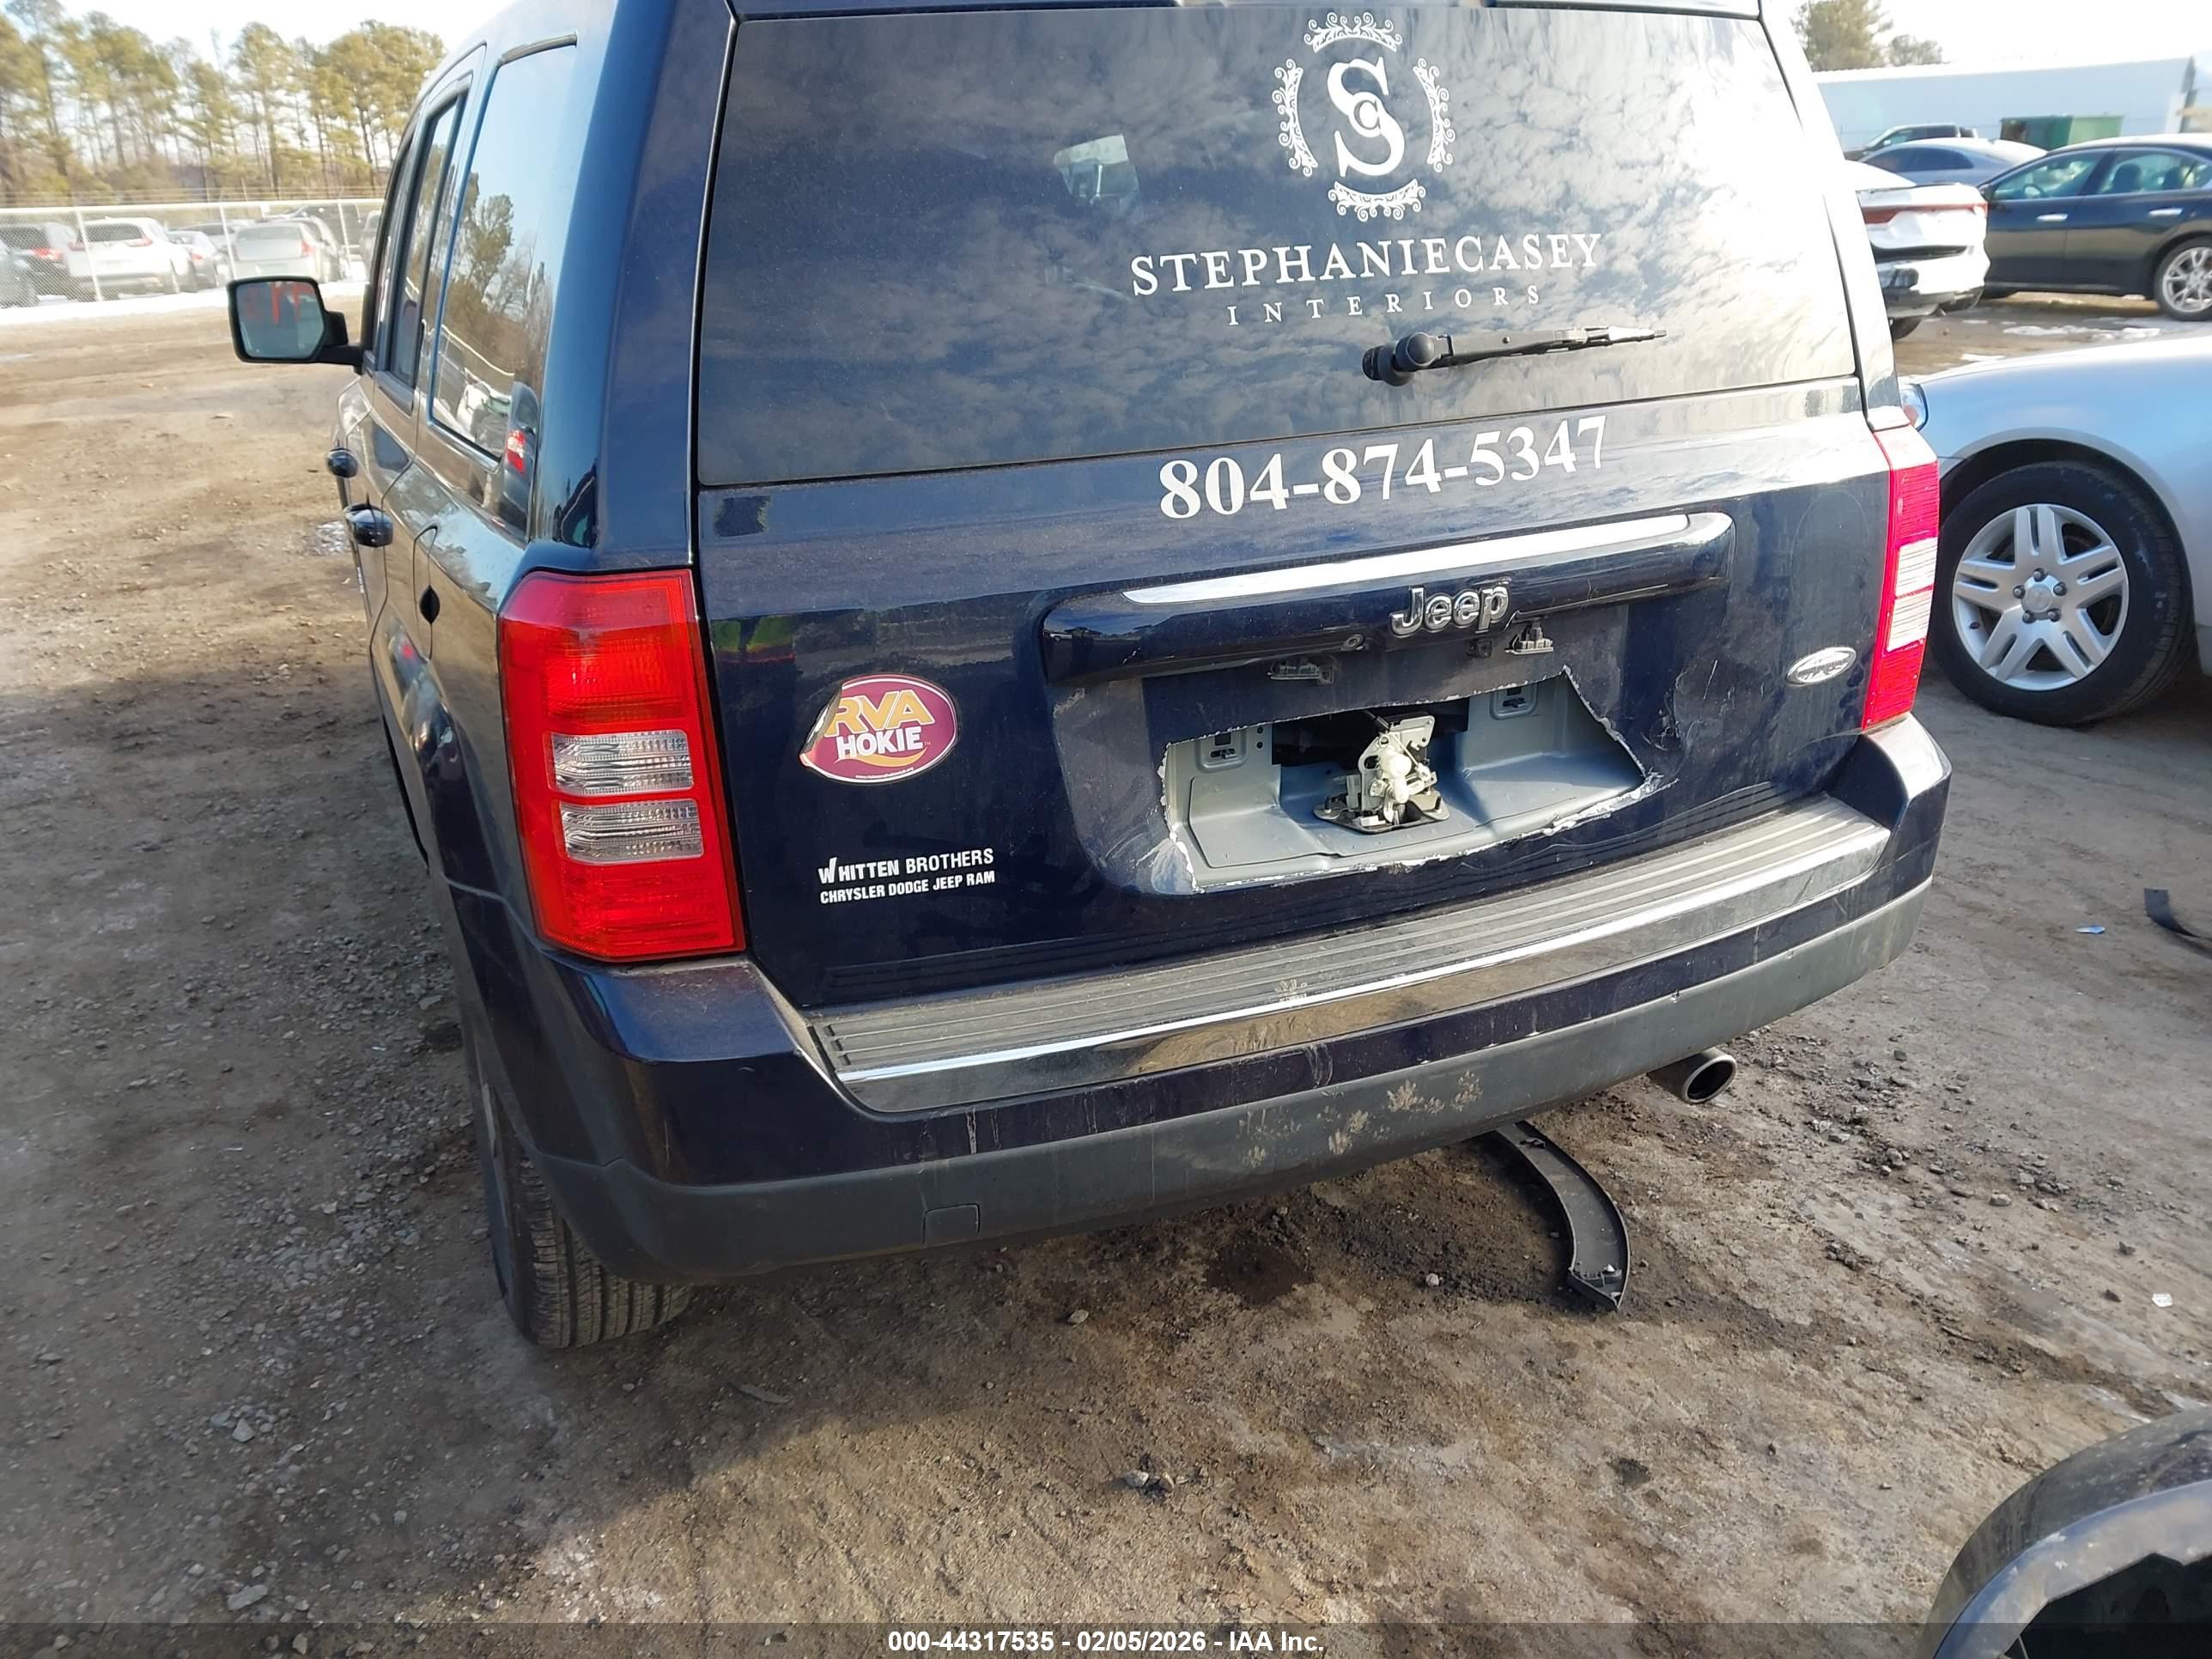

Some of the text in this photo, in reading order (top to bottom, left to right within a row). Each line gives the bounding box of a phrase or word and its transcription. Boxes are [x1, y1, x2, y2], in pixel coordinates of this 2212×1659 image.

[1131, 234, 1601, 297] STEPHANIECASEY
[1227, 285, 1540, 326] INTERIORS
[1159, 416, 1607, 519] 804-874-5347
[1389, 576, 1511, 638] Jeep
[824, 689, 935, 738] RVA
[836, 726, 924, 759] HOKIE
[818, 848, 994, 884] WHITTEN BROTHERS
[820, 870, 995, 904] CHRYSLER DODGE JEEP RAM
